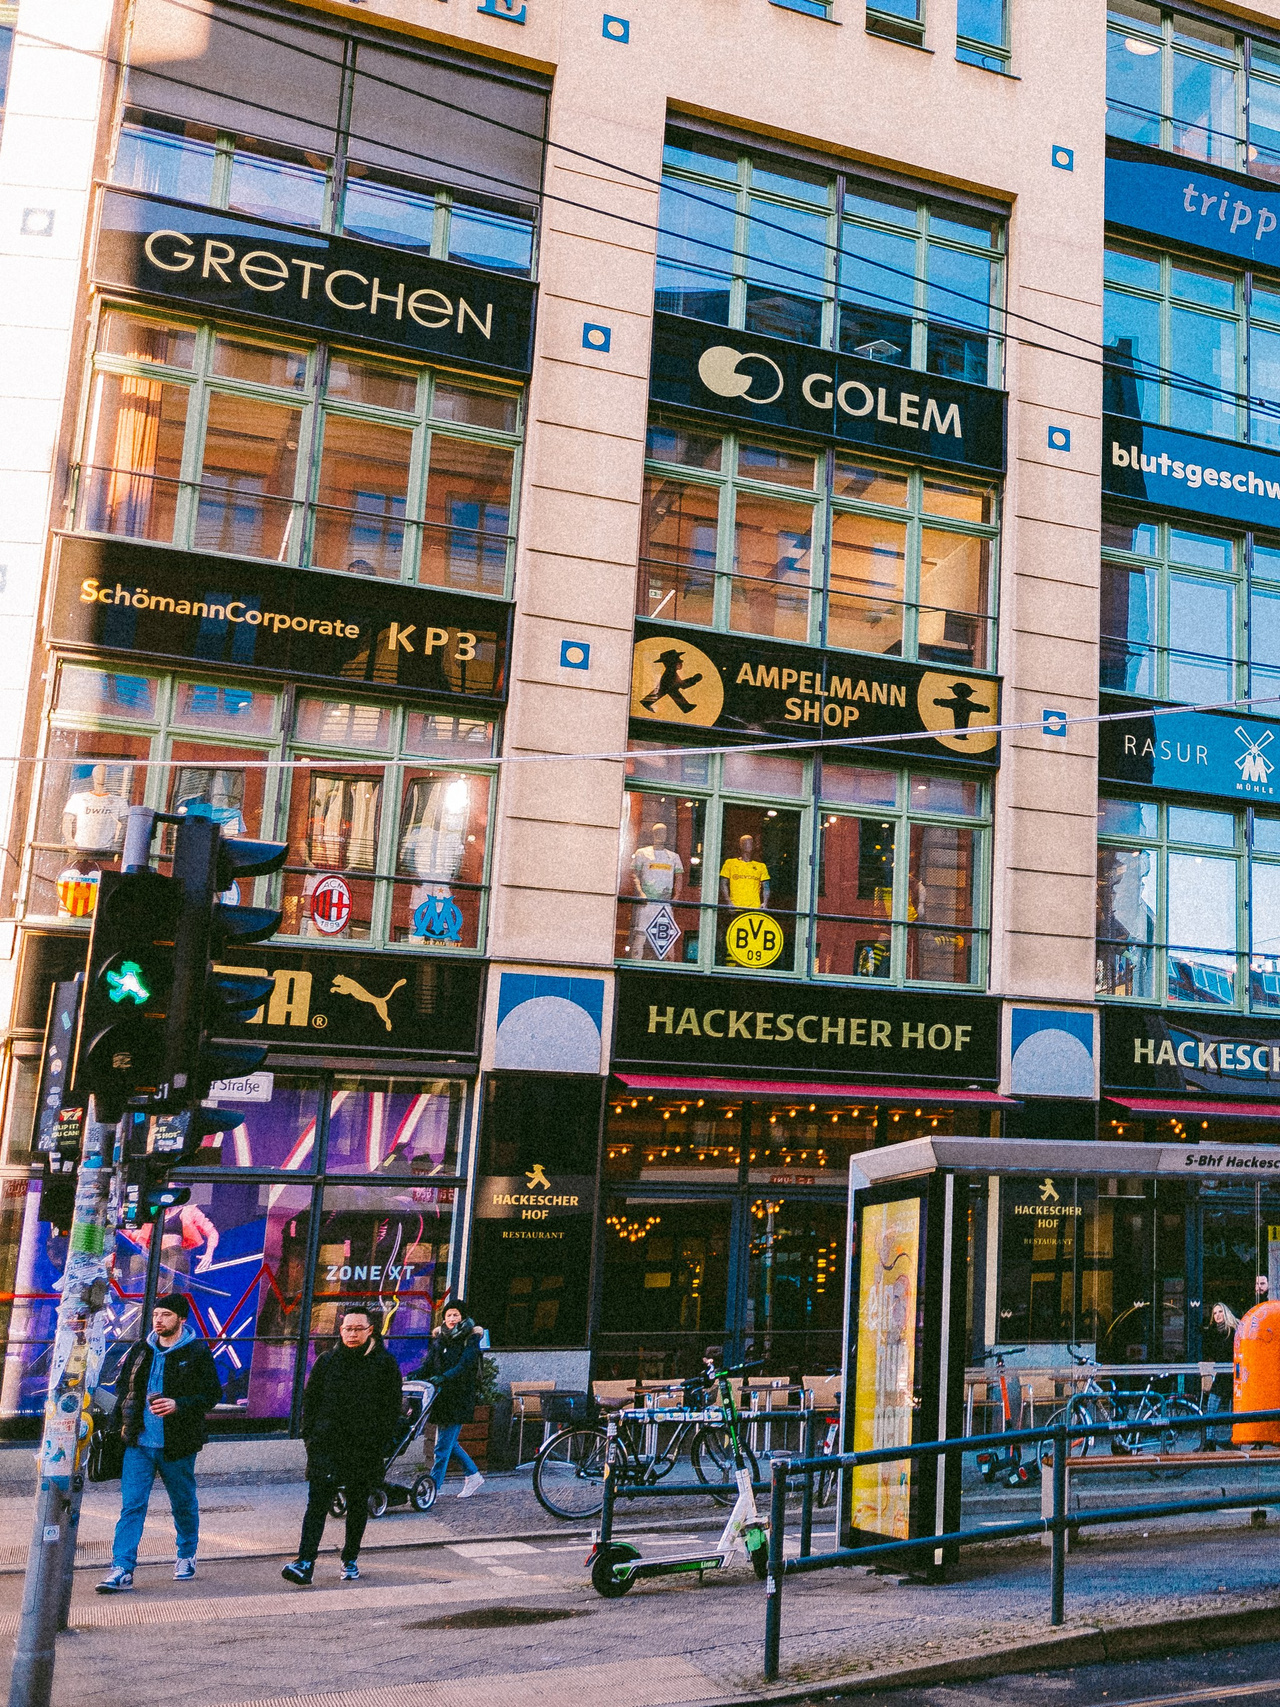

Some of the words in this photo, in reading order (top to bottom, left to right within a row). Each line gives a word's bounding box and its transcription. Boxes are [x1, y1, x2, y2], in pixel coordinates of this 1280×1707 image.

[802, 372, 963, 439] GOLEM
[79, 577, 361, 641] SchömannCorporate
[735, 662, 907, 709] AMPELMANN
[784, 697, 860, 729] SHOP
[1124, 734, 1209, 766] RASUR
[1236, 782, 1275, 794] MÜHLE
[320, 920, 340, 929] 1899
[736, 918, 776, 951] BVB
[747, 949, 762, 961] 09
[647, 1005, 893, 1049] HACKESCHER
[901, 1021, 972, 1052] HOF
[217, 1078, 260, 1095] Straße
[1185, 1154, 1224, 1170] S-Bhf
[492, 1194, 579, 1207] HACKESCHER
[521, 1208, 550, 1221] HOF
[1014, 1205, 1083, 1216] HACKESCHER
[1037, 1218, 1060, 1229] HOF
[502, 1230, 565, 1240] RESTAURANT
[1023, 1237, 1073, 1246] RESTAURANT
[326, 1265, 382, 1281] ZONE
[388, 1265, 415, 1281] XT
